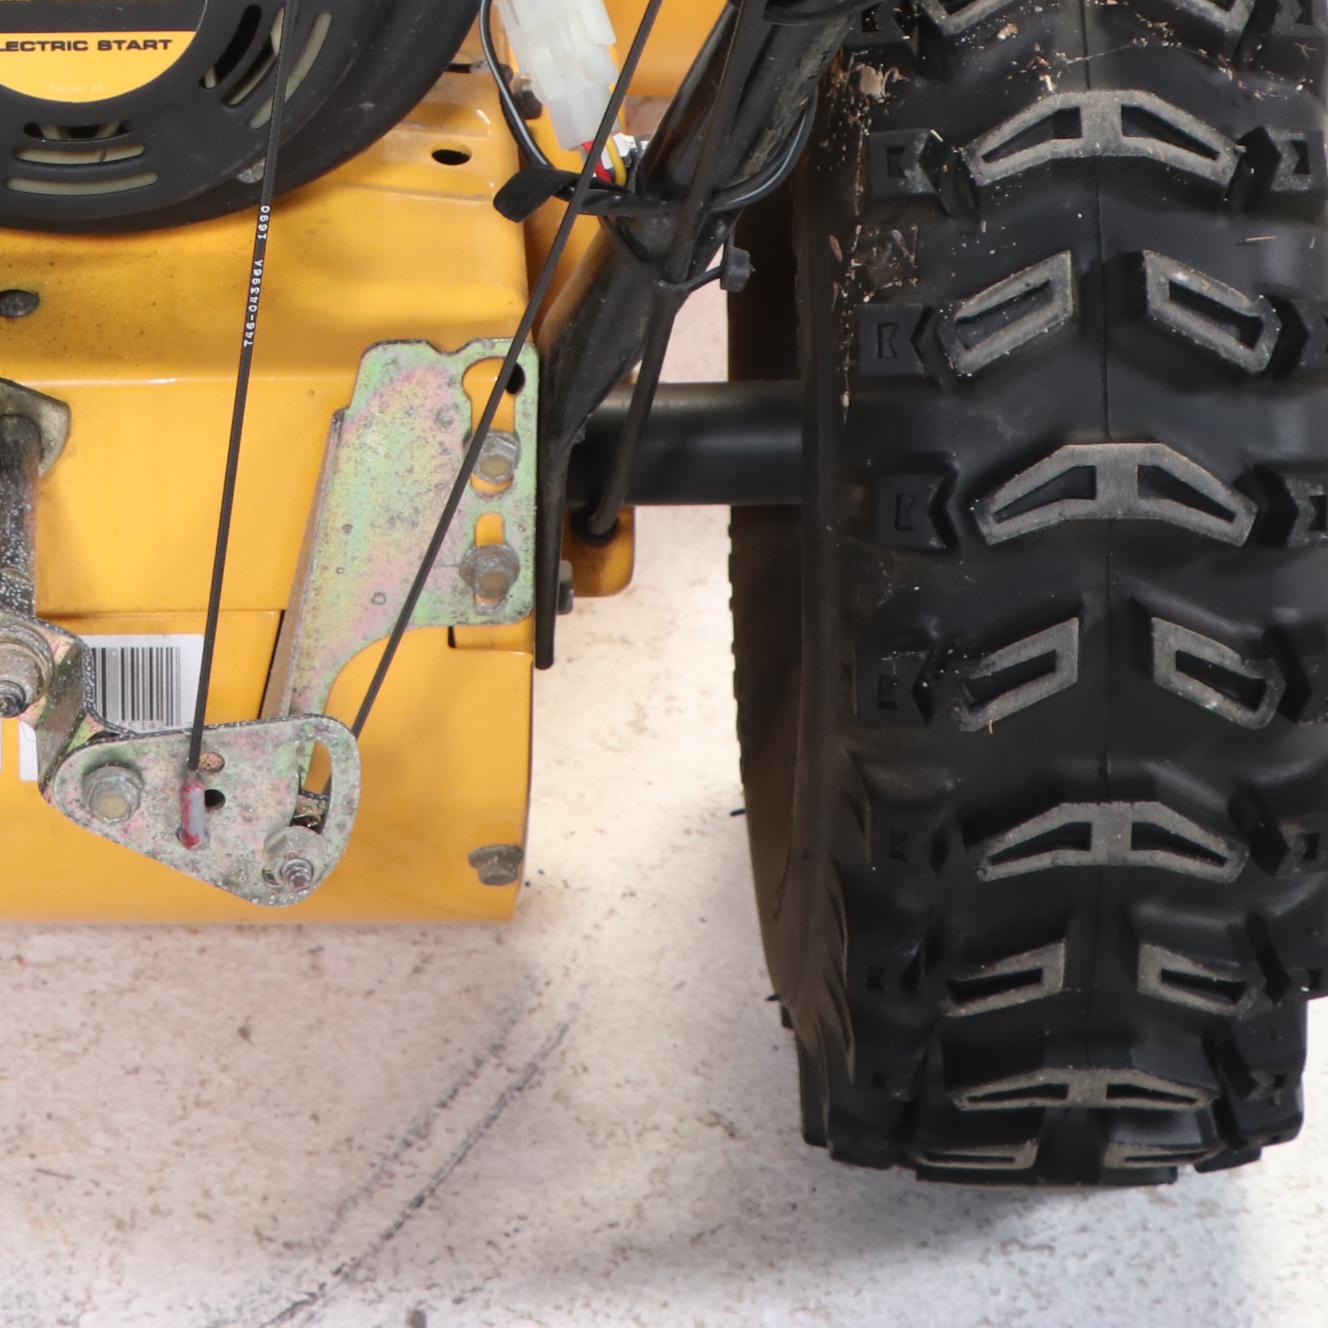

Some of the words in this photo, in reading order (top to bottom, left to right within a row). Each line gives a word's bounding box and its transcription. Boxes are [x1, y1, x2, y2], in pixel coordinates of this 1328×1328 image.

[97, 39, 172, 51] START
[243, 259, 264, 347] 746-04396A
[257, 205, 271, 240] 1690
